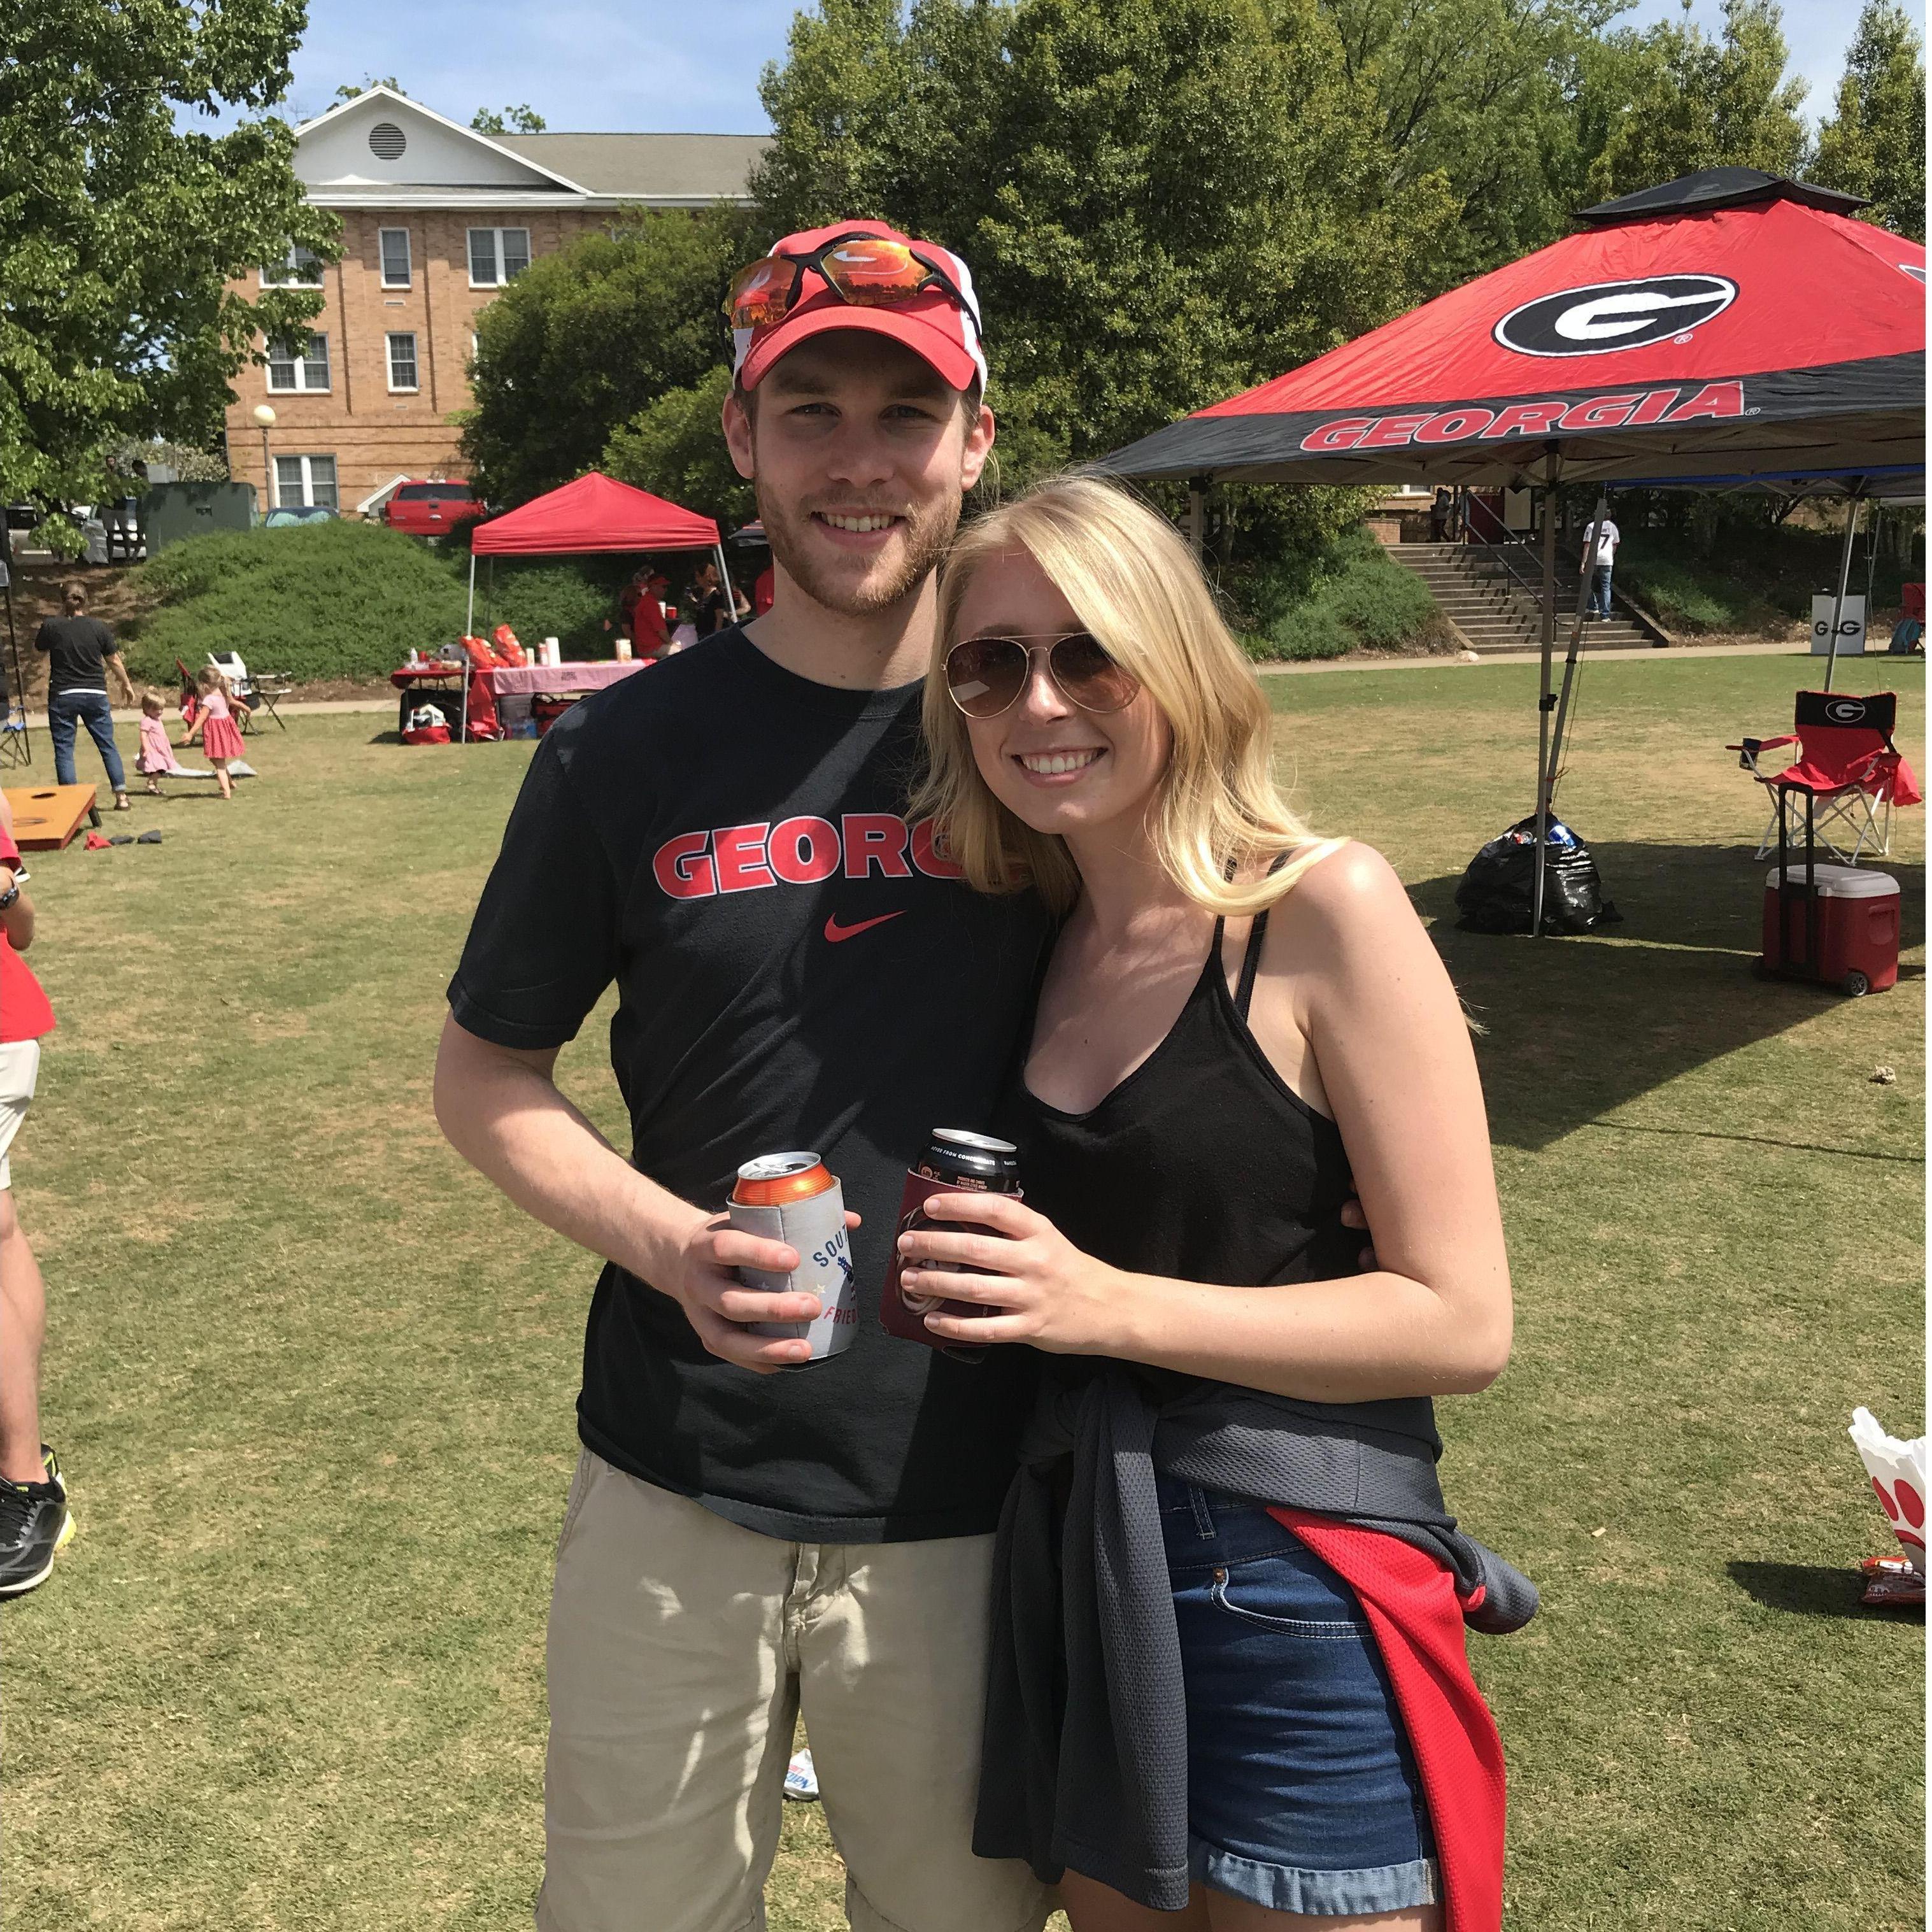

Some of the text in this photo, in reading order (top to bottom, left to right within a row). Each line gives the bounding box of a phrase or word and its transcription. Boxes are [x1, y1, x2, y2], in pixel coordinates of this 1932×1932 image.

[1300, 380, 1744, 451] GEORGIA
[653, 813, 969, 899] GEORG
[942, 1149, 957, 1158] FROM
[823, 1305, 857, 1325] FRIED
